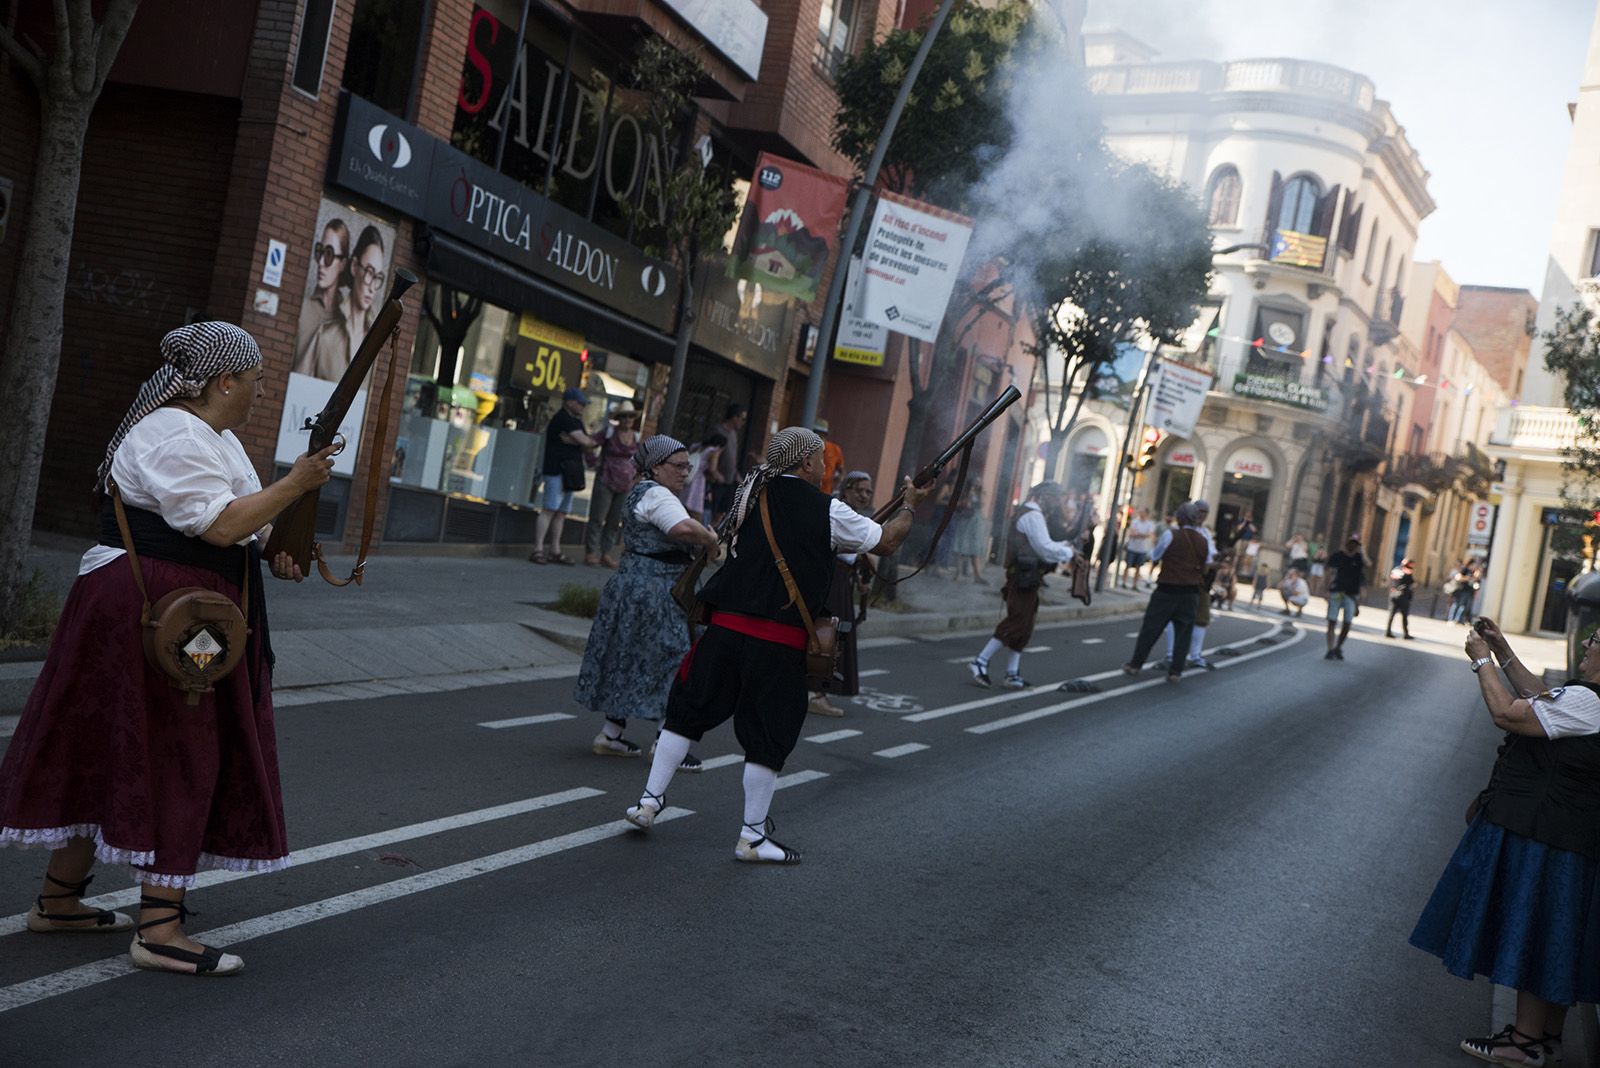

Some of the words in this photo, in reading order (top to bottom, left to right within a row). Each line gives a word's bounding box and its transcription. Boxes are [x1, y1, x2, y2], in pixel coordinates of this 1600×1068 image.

[458, 9, 679, 226] SALDON
[761, 169, 781, 183] 112
[450, 167, 532, 252] ÒPTICA
[540, 222, 619, 290] SALDON
[869, 252, 880, 263] de
[880, 255, 920, 277] prevenció
[873, 239, 899, 256] Coneix
[900, 247, 913, 260] les
[914, 254, 948, 271] mesures
[525, 346, 567, 393] -50%
[1234, 460, 1264, 474] GAES
